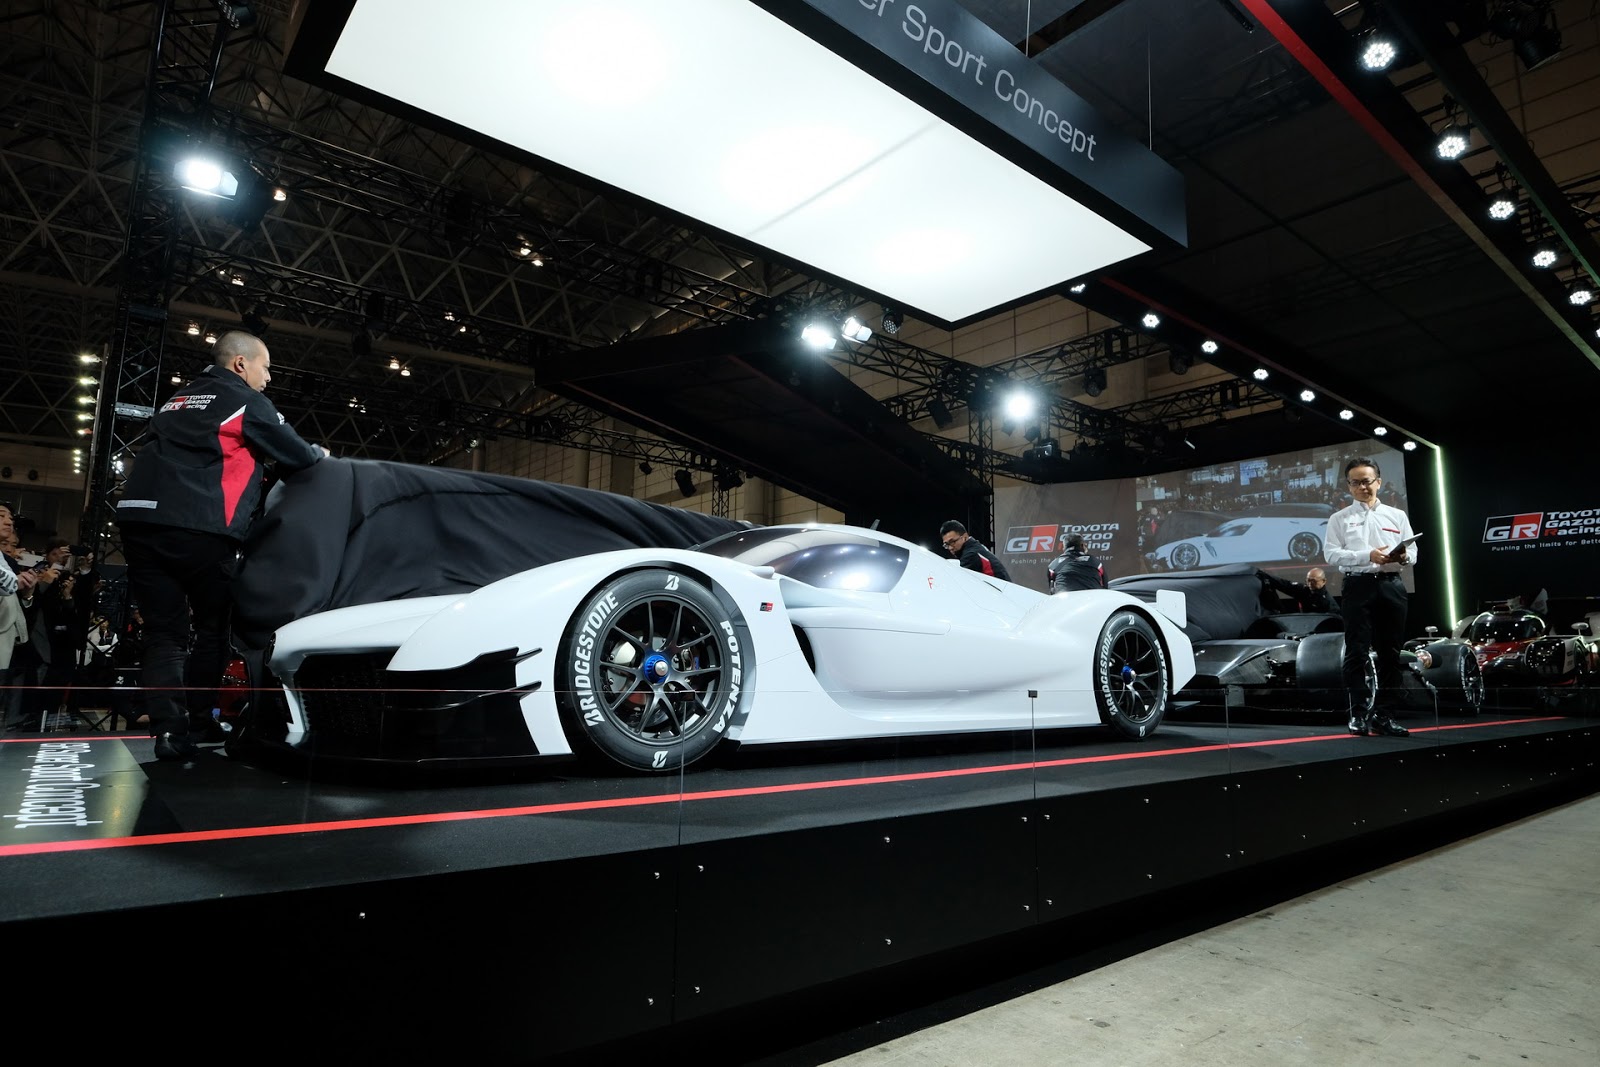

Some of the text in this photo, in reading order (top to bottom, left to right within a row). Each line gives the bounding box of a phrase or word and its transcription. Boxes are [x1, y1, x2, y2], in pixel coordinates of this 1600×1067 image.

[902, 4, 987, 86] Sport
[994, 69, 1097, 161] Concept
[160, 401, 184, 412] GR
[1006, 532, 1113, 552] GR GZOO
[1061, 523, 1119, 533] TOYOTA
[1485, 523, 1539, 540] GR
[574, 591, 619, 727] BRIDGESTONE
[1100, 630, 1119, 716] BRIDGESTONE
[713, 620, 741, 733] POTENZA
[21, 763, 95, 782] Sport
[3, 783, 103, 828] Concept
